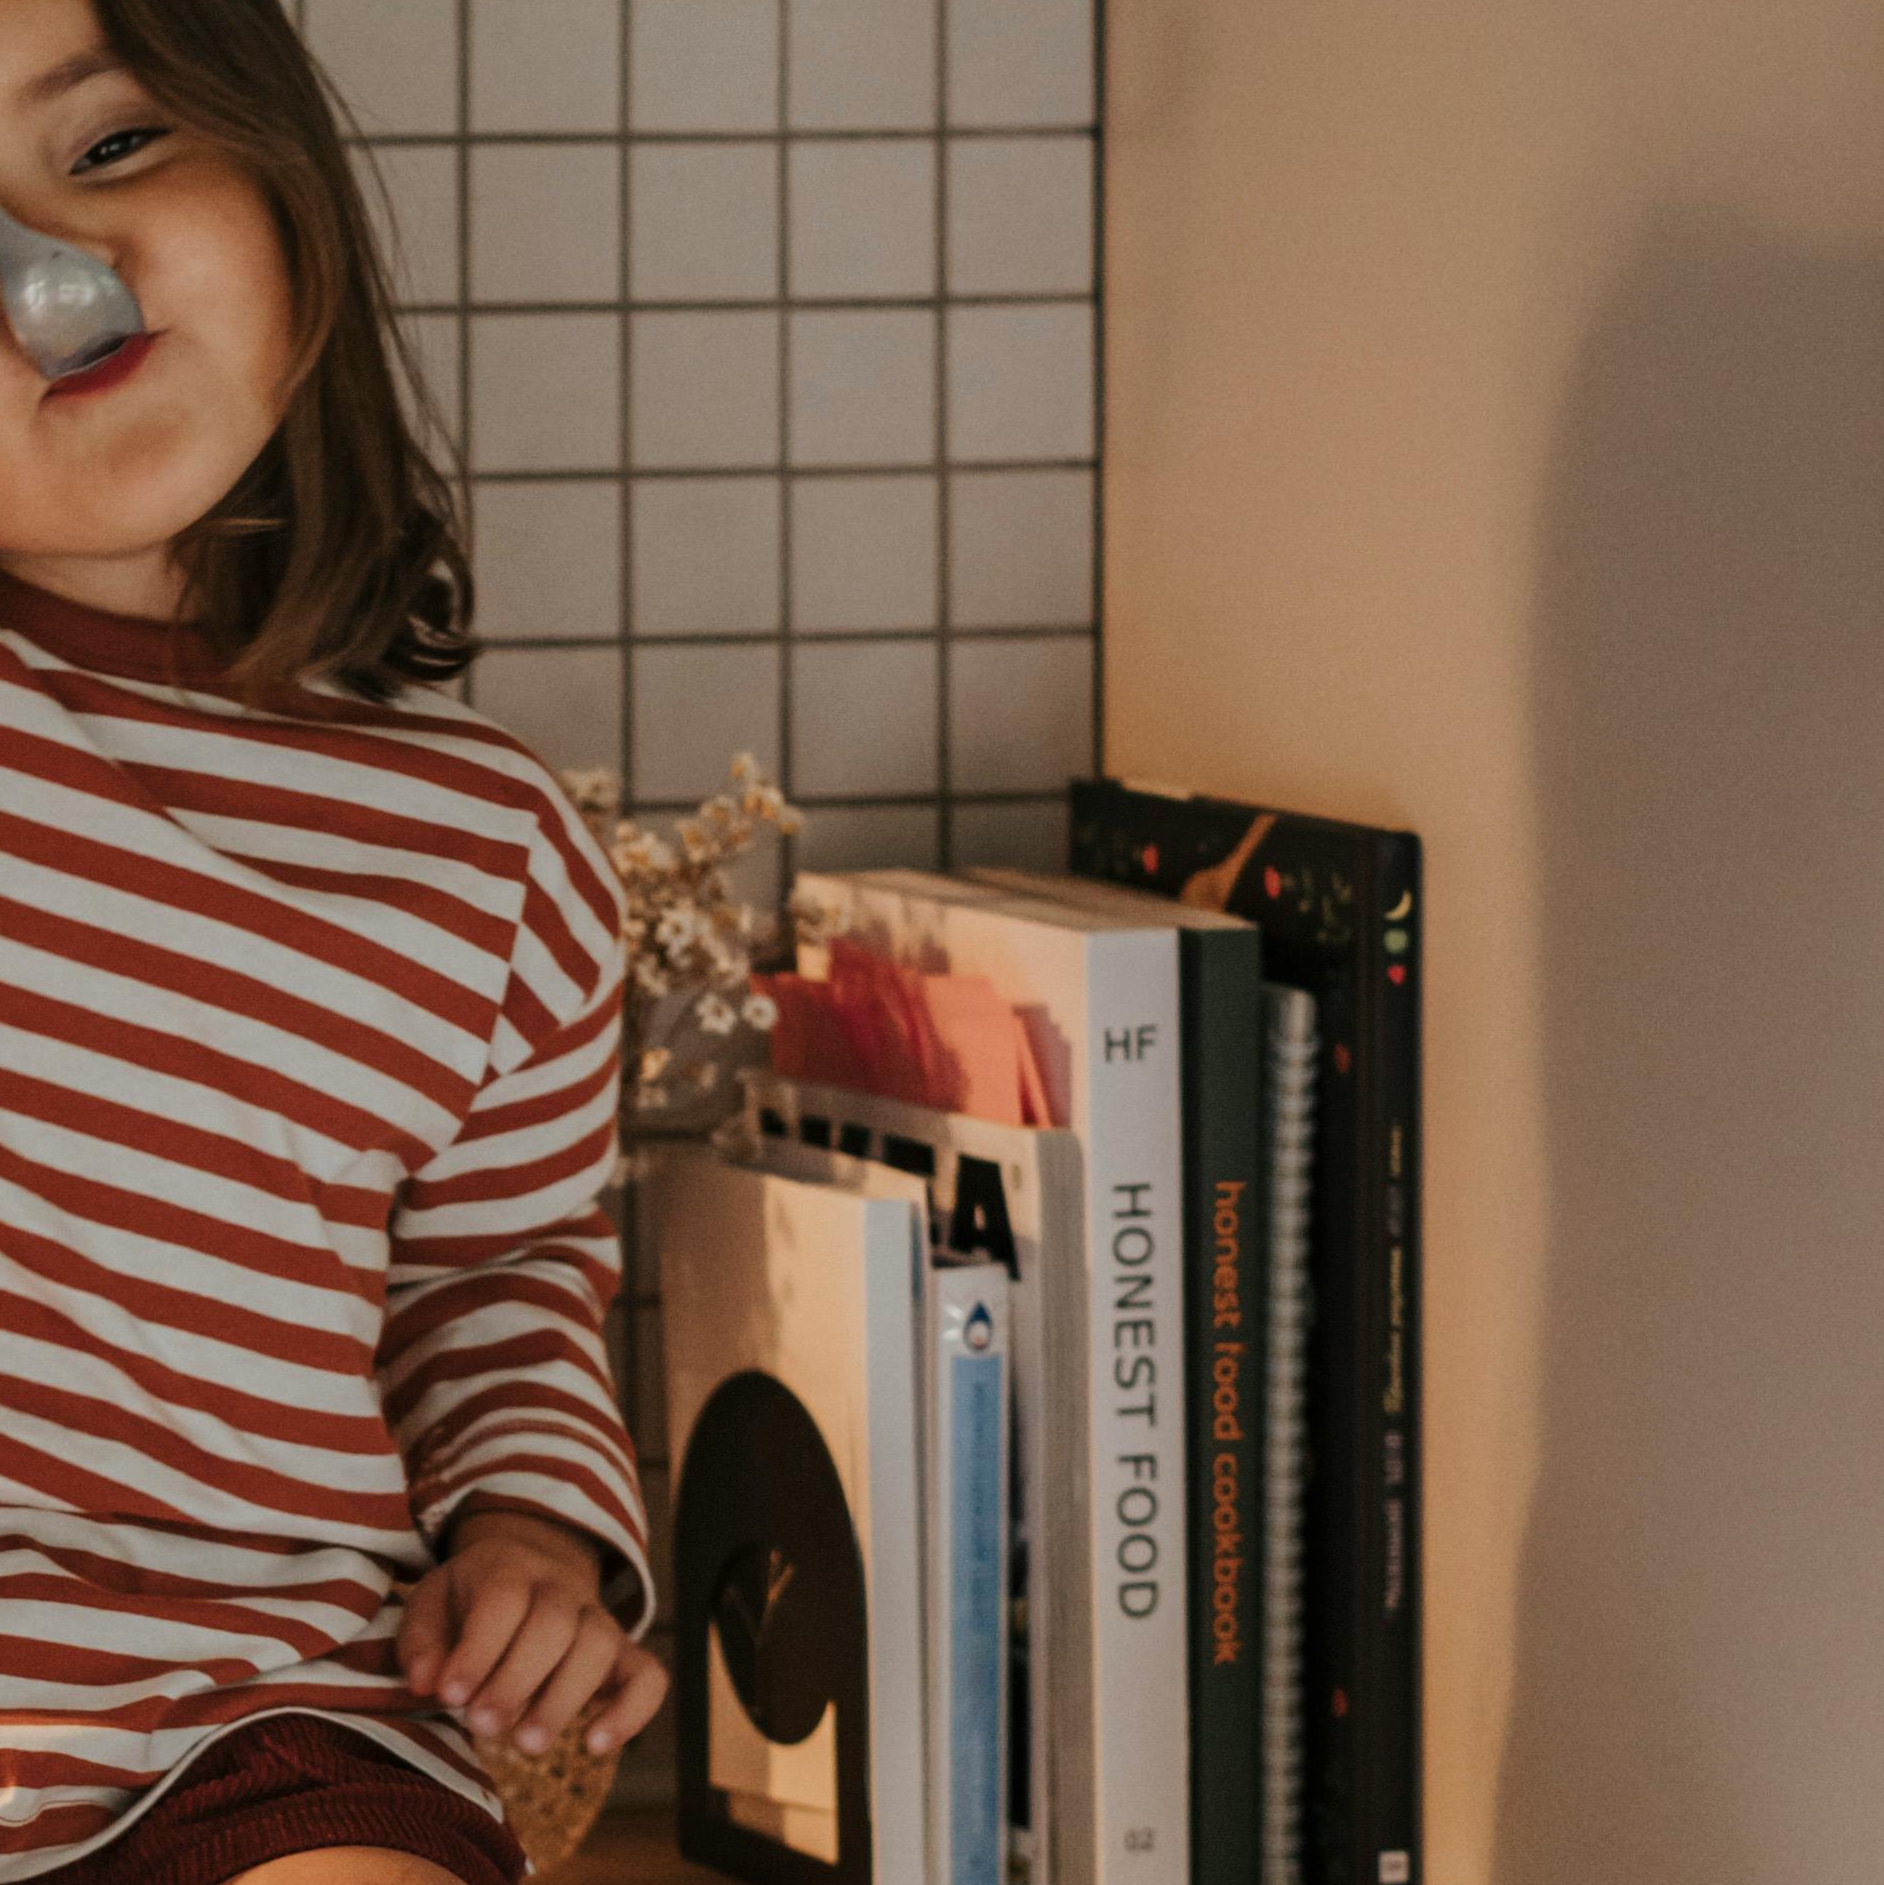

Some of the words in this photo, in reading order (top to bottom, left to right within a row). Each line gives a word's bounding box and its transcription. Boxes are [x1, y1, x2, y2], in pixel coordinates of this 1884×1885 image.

[1104, 1024, 1157, 1063] HF
[1111, 1182, 1157, 1427] HONEST
[1213, 1180, 1247, 1329] honest
[1213, 1341, 1247, 1441] food
[1115, 1453, 1159, 1619] FOOD
[1213, 1453, 1244, 1664] cookbook
